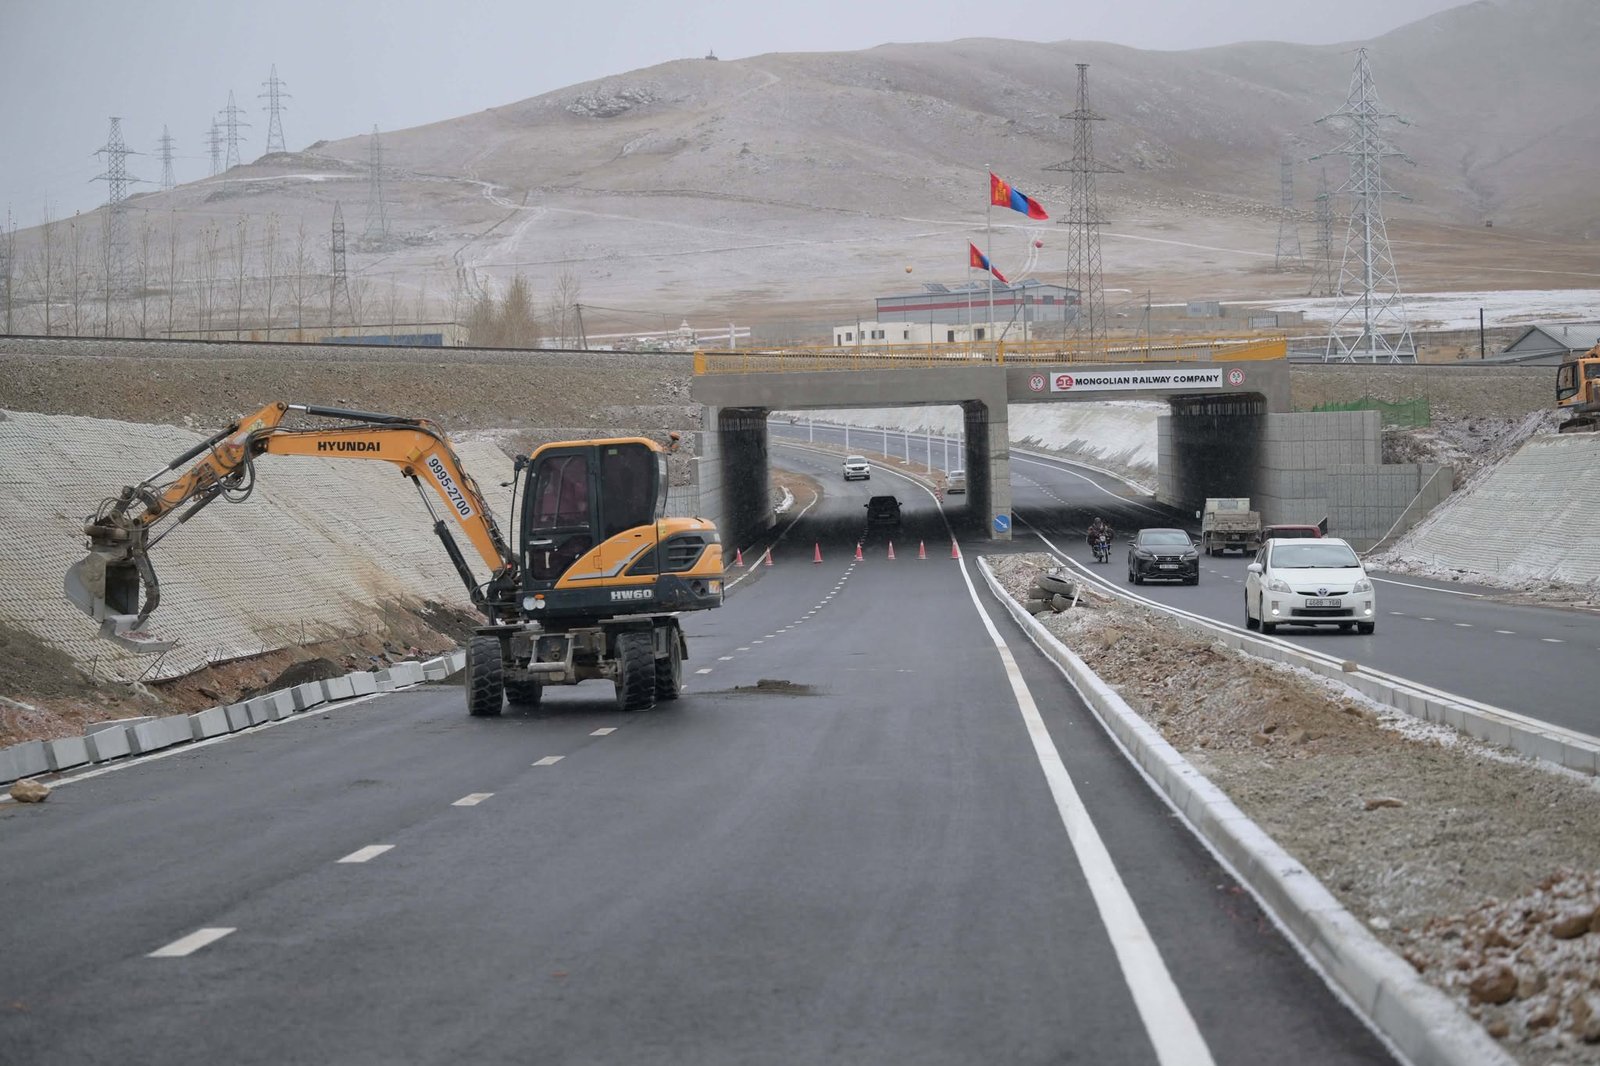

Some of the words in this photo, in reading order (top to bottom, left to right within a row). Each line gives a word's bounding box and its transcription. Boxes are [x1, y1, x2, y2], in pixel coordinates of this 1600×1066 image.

[1075, 376, 1131, 386] MONGOLIAN
[1132, 375, 1171, 385] RAILWAY
[1173, 374, 1219, 383] COMPANY
[317, 441, 381, 452] HYUNDAI
[428, 458, 471, 516] 9995-2700
[610, 589, 654, 600] HW60
